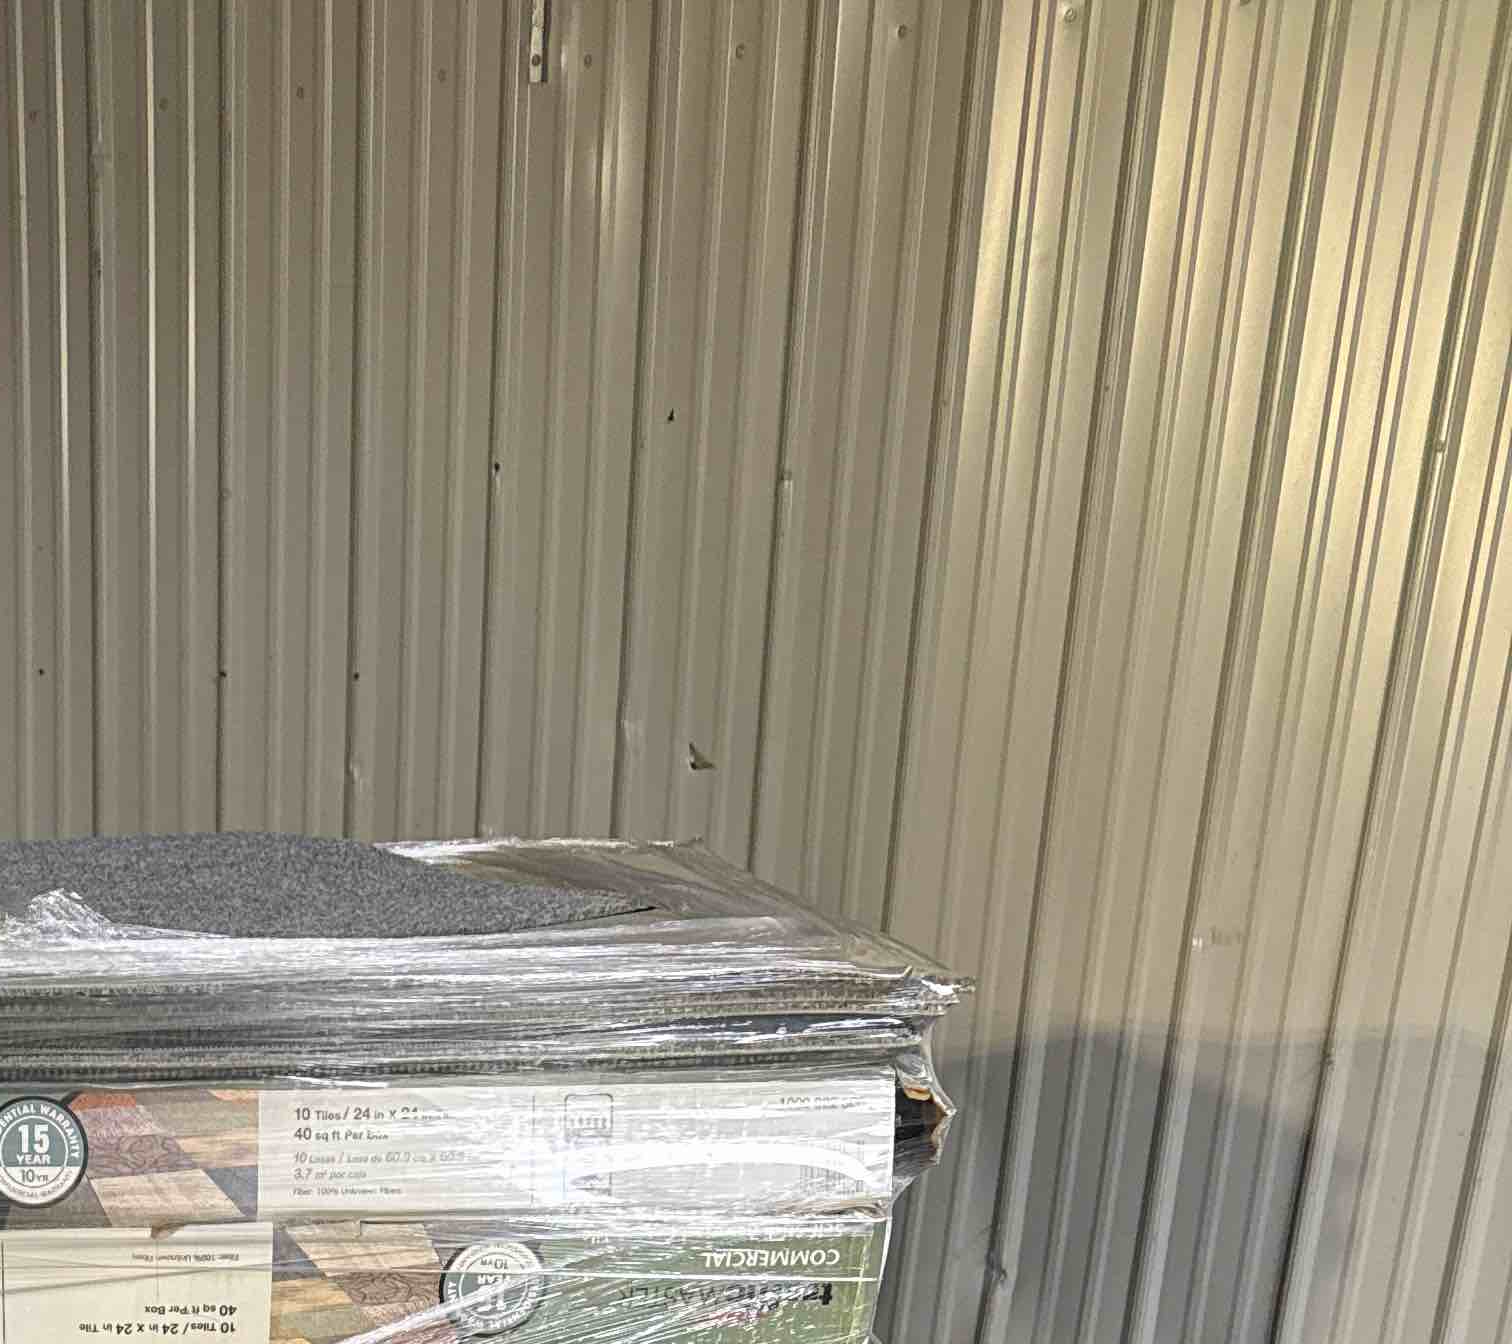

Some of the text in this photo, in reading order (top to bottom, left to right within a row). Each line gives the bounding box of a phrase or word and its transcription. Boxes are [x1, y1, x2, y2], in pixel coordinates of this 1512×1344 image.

[294, 1107, 384, 1121] 10 24 in
[40, 1103, 81, 1159] WARRANTY
[294, 1127, 364, 1142] 40 sq ft Per
[18, 1124, 50, 1154] 15
[16, 1154, 51, 1165] YEAR
[21, 1168, 35, 1183] 10
[702, 1248, 841, 1269] COMMERCIAL
[144, 1303, 237, 1317] 40 sq ft Per Box
[78, 1323, 99, 1334] Tile
[103, 1323, 113, 1334] in
[116, 1322, 133, 1335] 24
[149, 1323, 159, 1334] in
[162, 1322, 178, 1335] 24
[220, 1321, 236, 1334] 10
